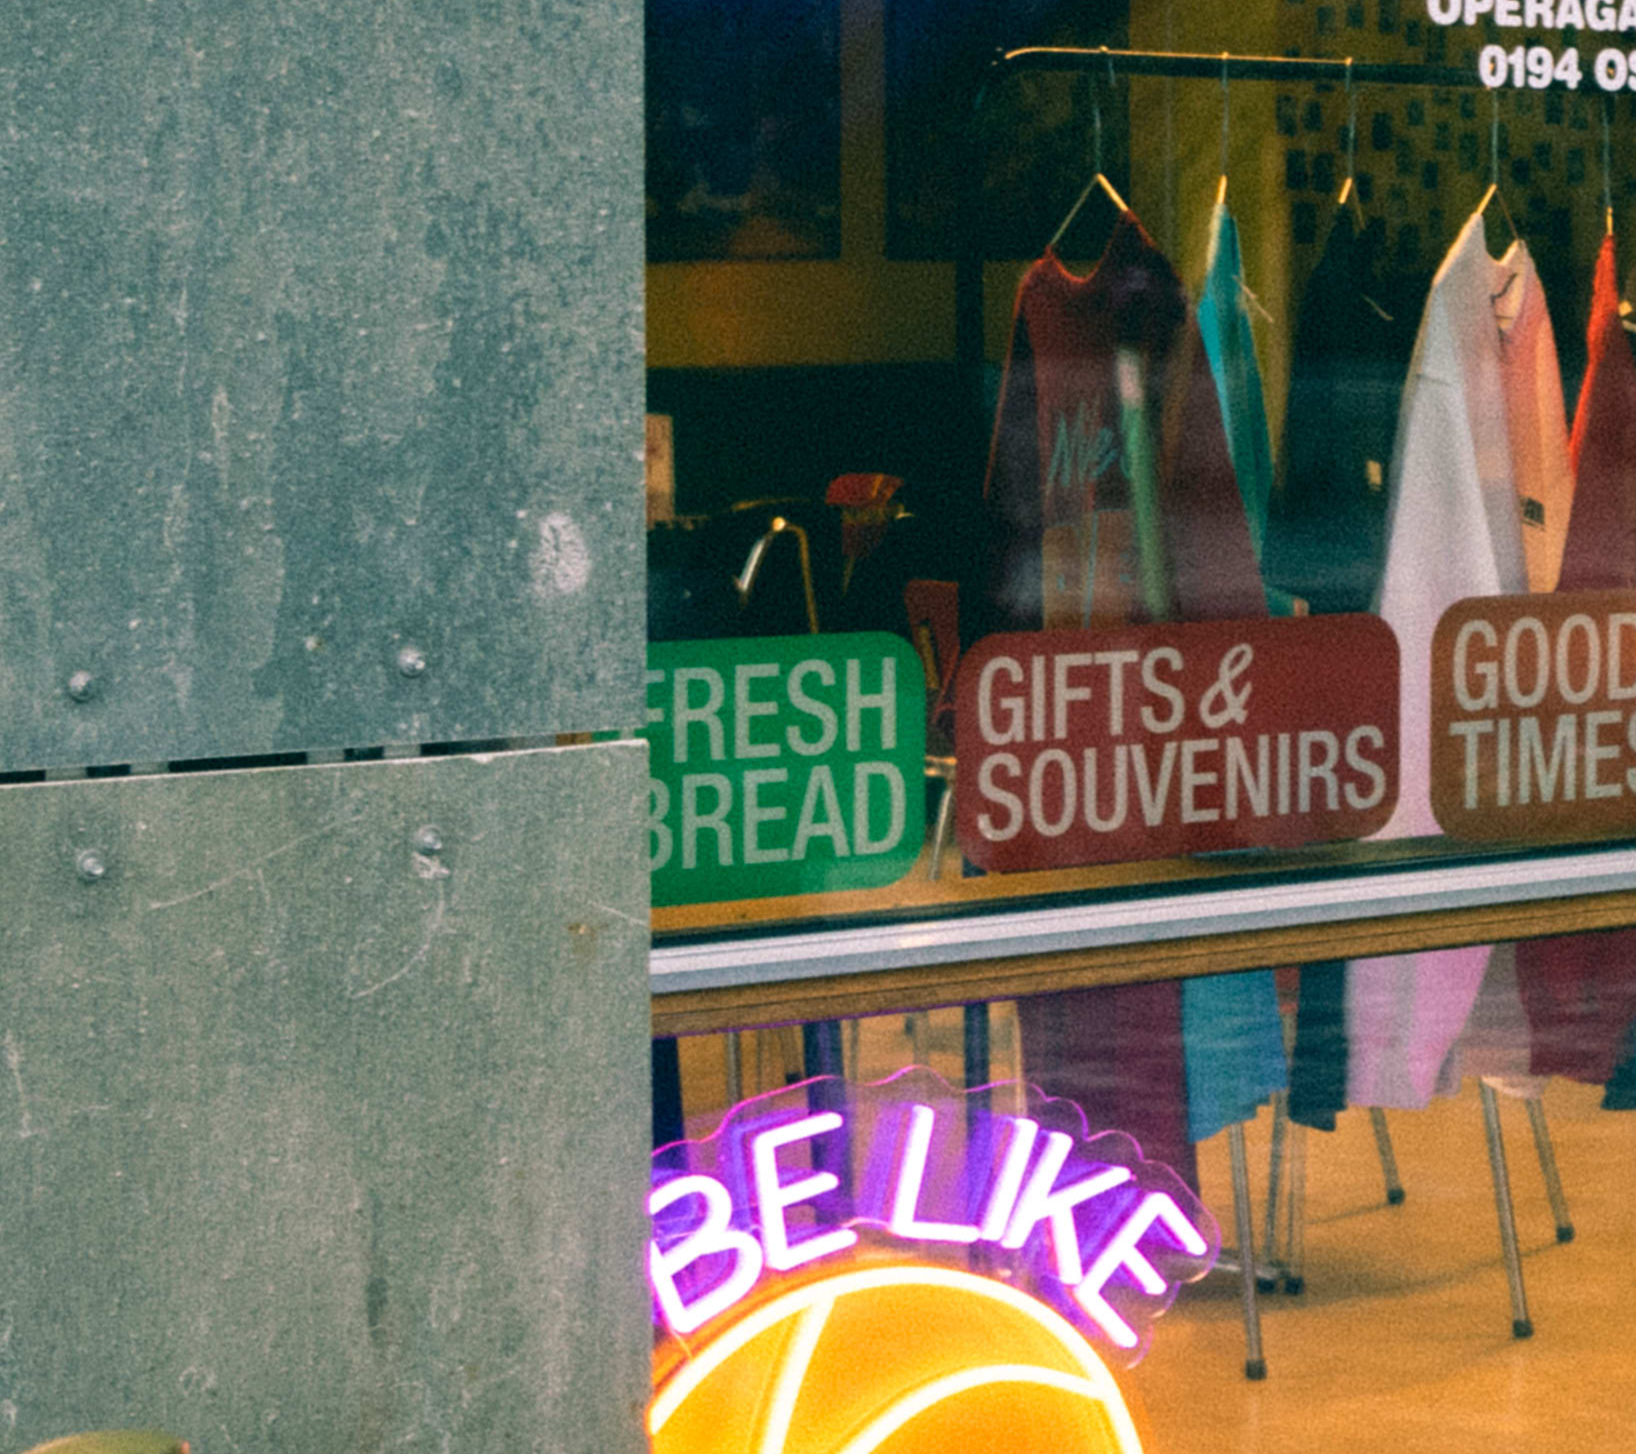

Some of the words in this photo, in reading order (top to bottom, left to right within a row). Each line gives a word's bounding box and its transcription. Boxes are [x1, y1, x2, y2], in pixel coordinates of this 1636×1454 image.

[1479, 45, 1582, 88] 0194
[977, 647, 1185, 745] GIFTS
[976, 725, 1386, 842] SOUVENIRS
[649, 1112, 857, 1332] BE
[893, 1104, 1207, 1347] LIKE
